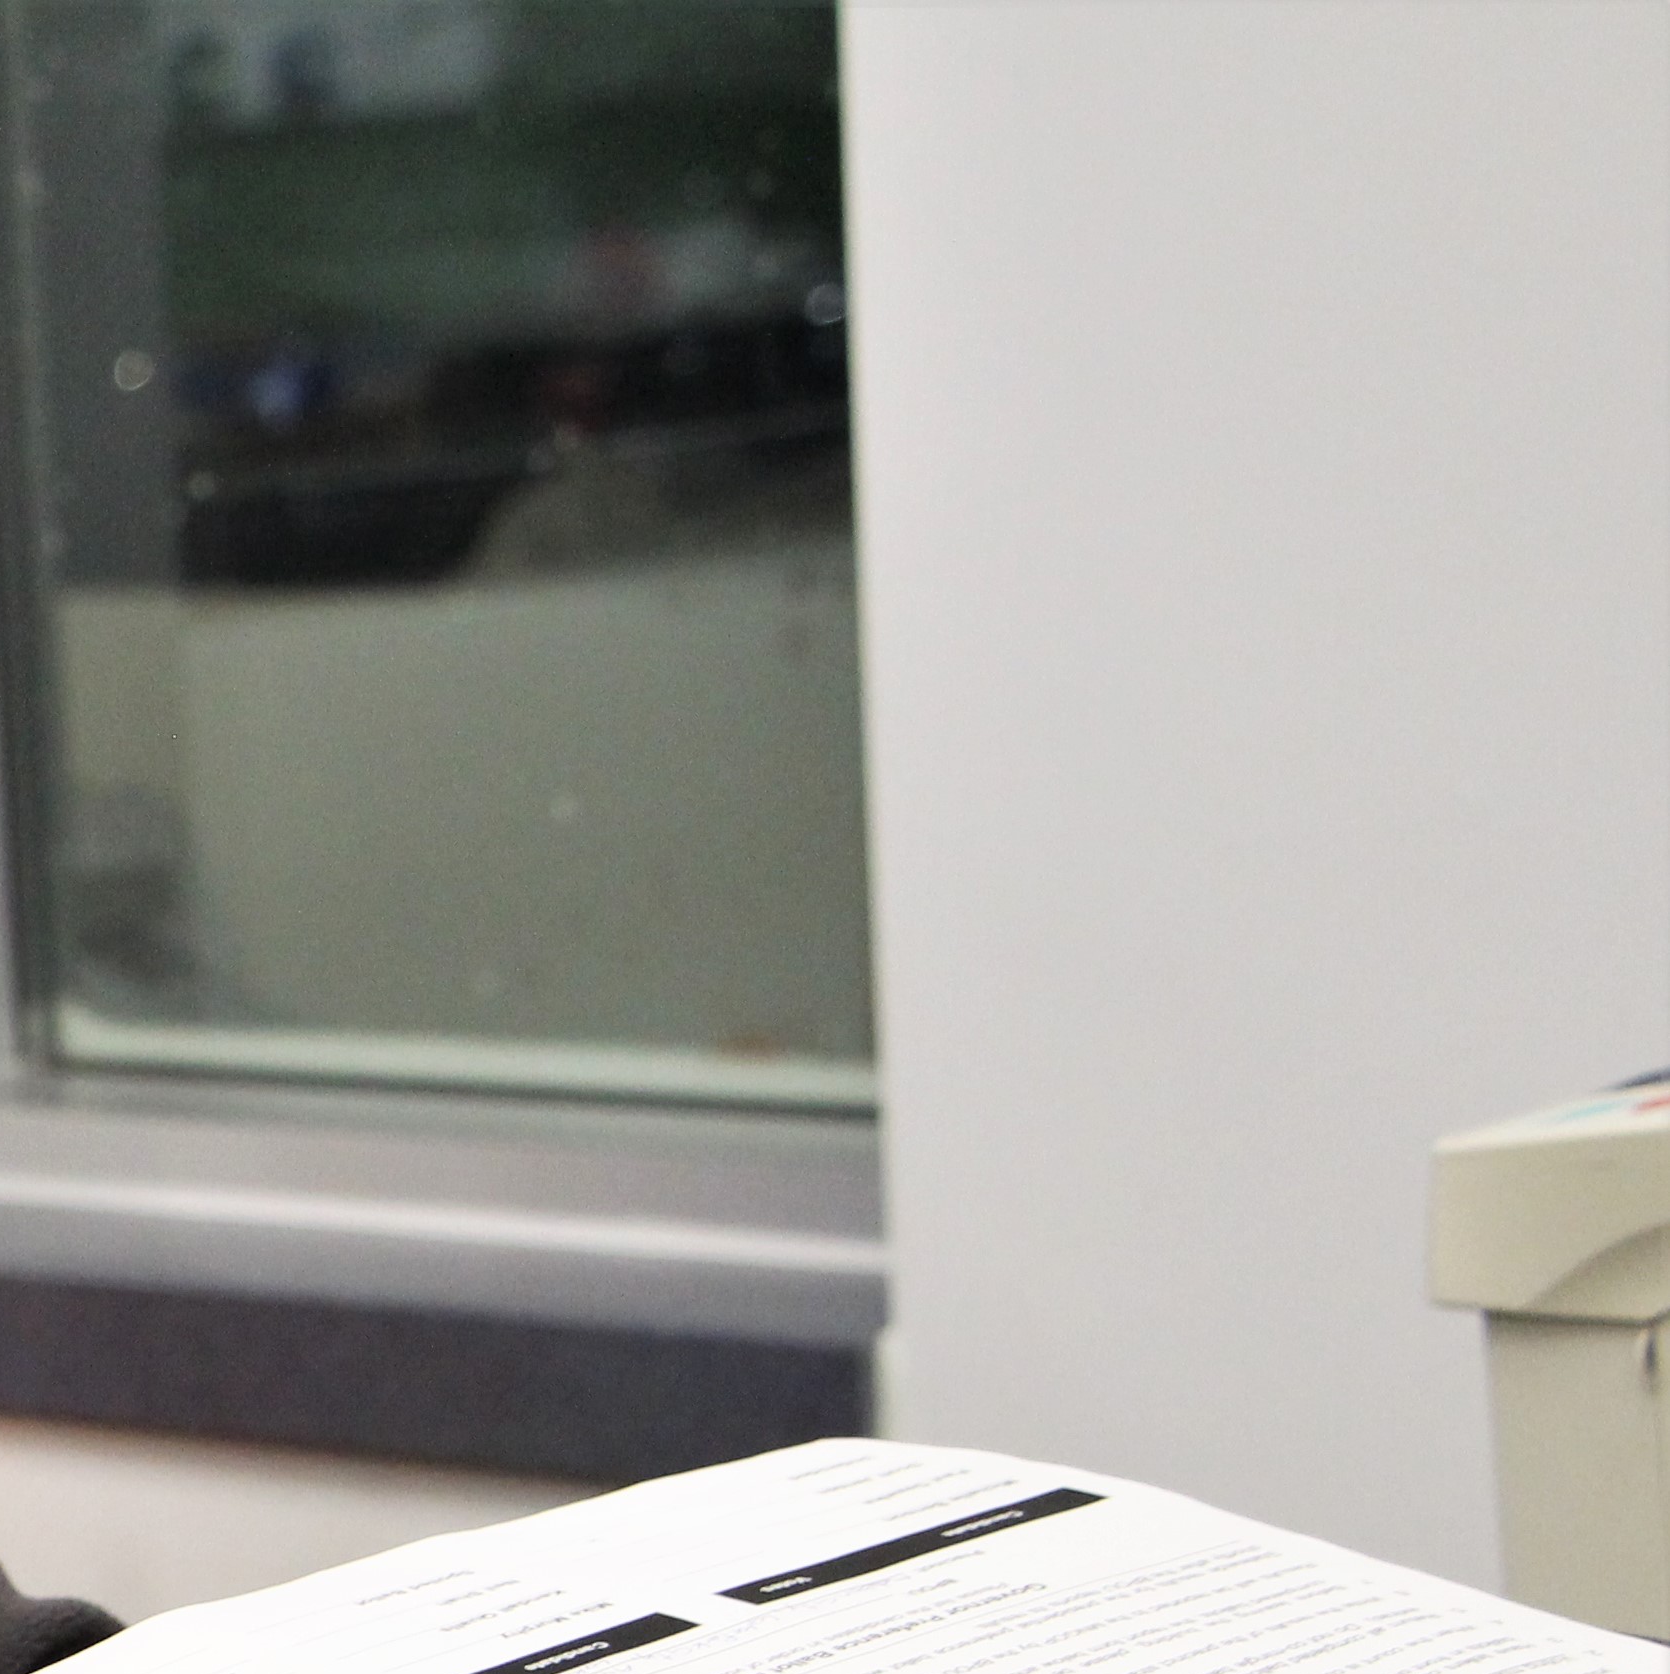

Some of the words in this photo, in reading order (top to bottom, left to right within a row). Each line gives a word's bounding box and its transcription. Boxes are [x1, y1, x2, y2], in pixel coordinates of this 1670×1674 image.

[947, 1583, 1048, 1616] Governor
[833, 1615, 945, 1651] Preference
[524, 1641, 609, 1671] Candidate
[771, 1650, 835, 1673] Ballot
